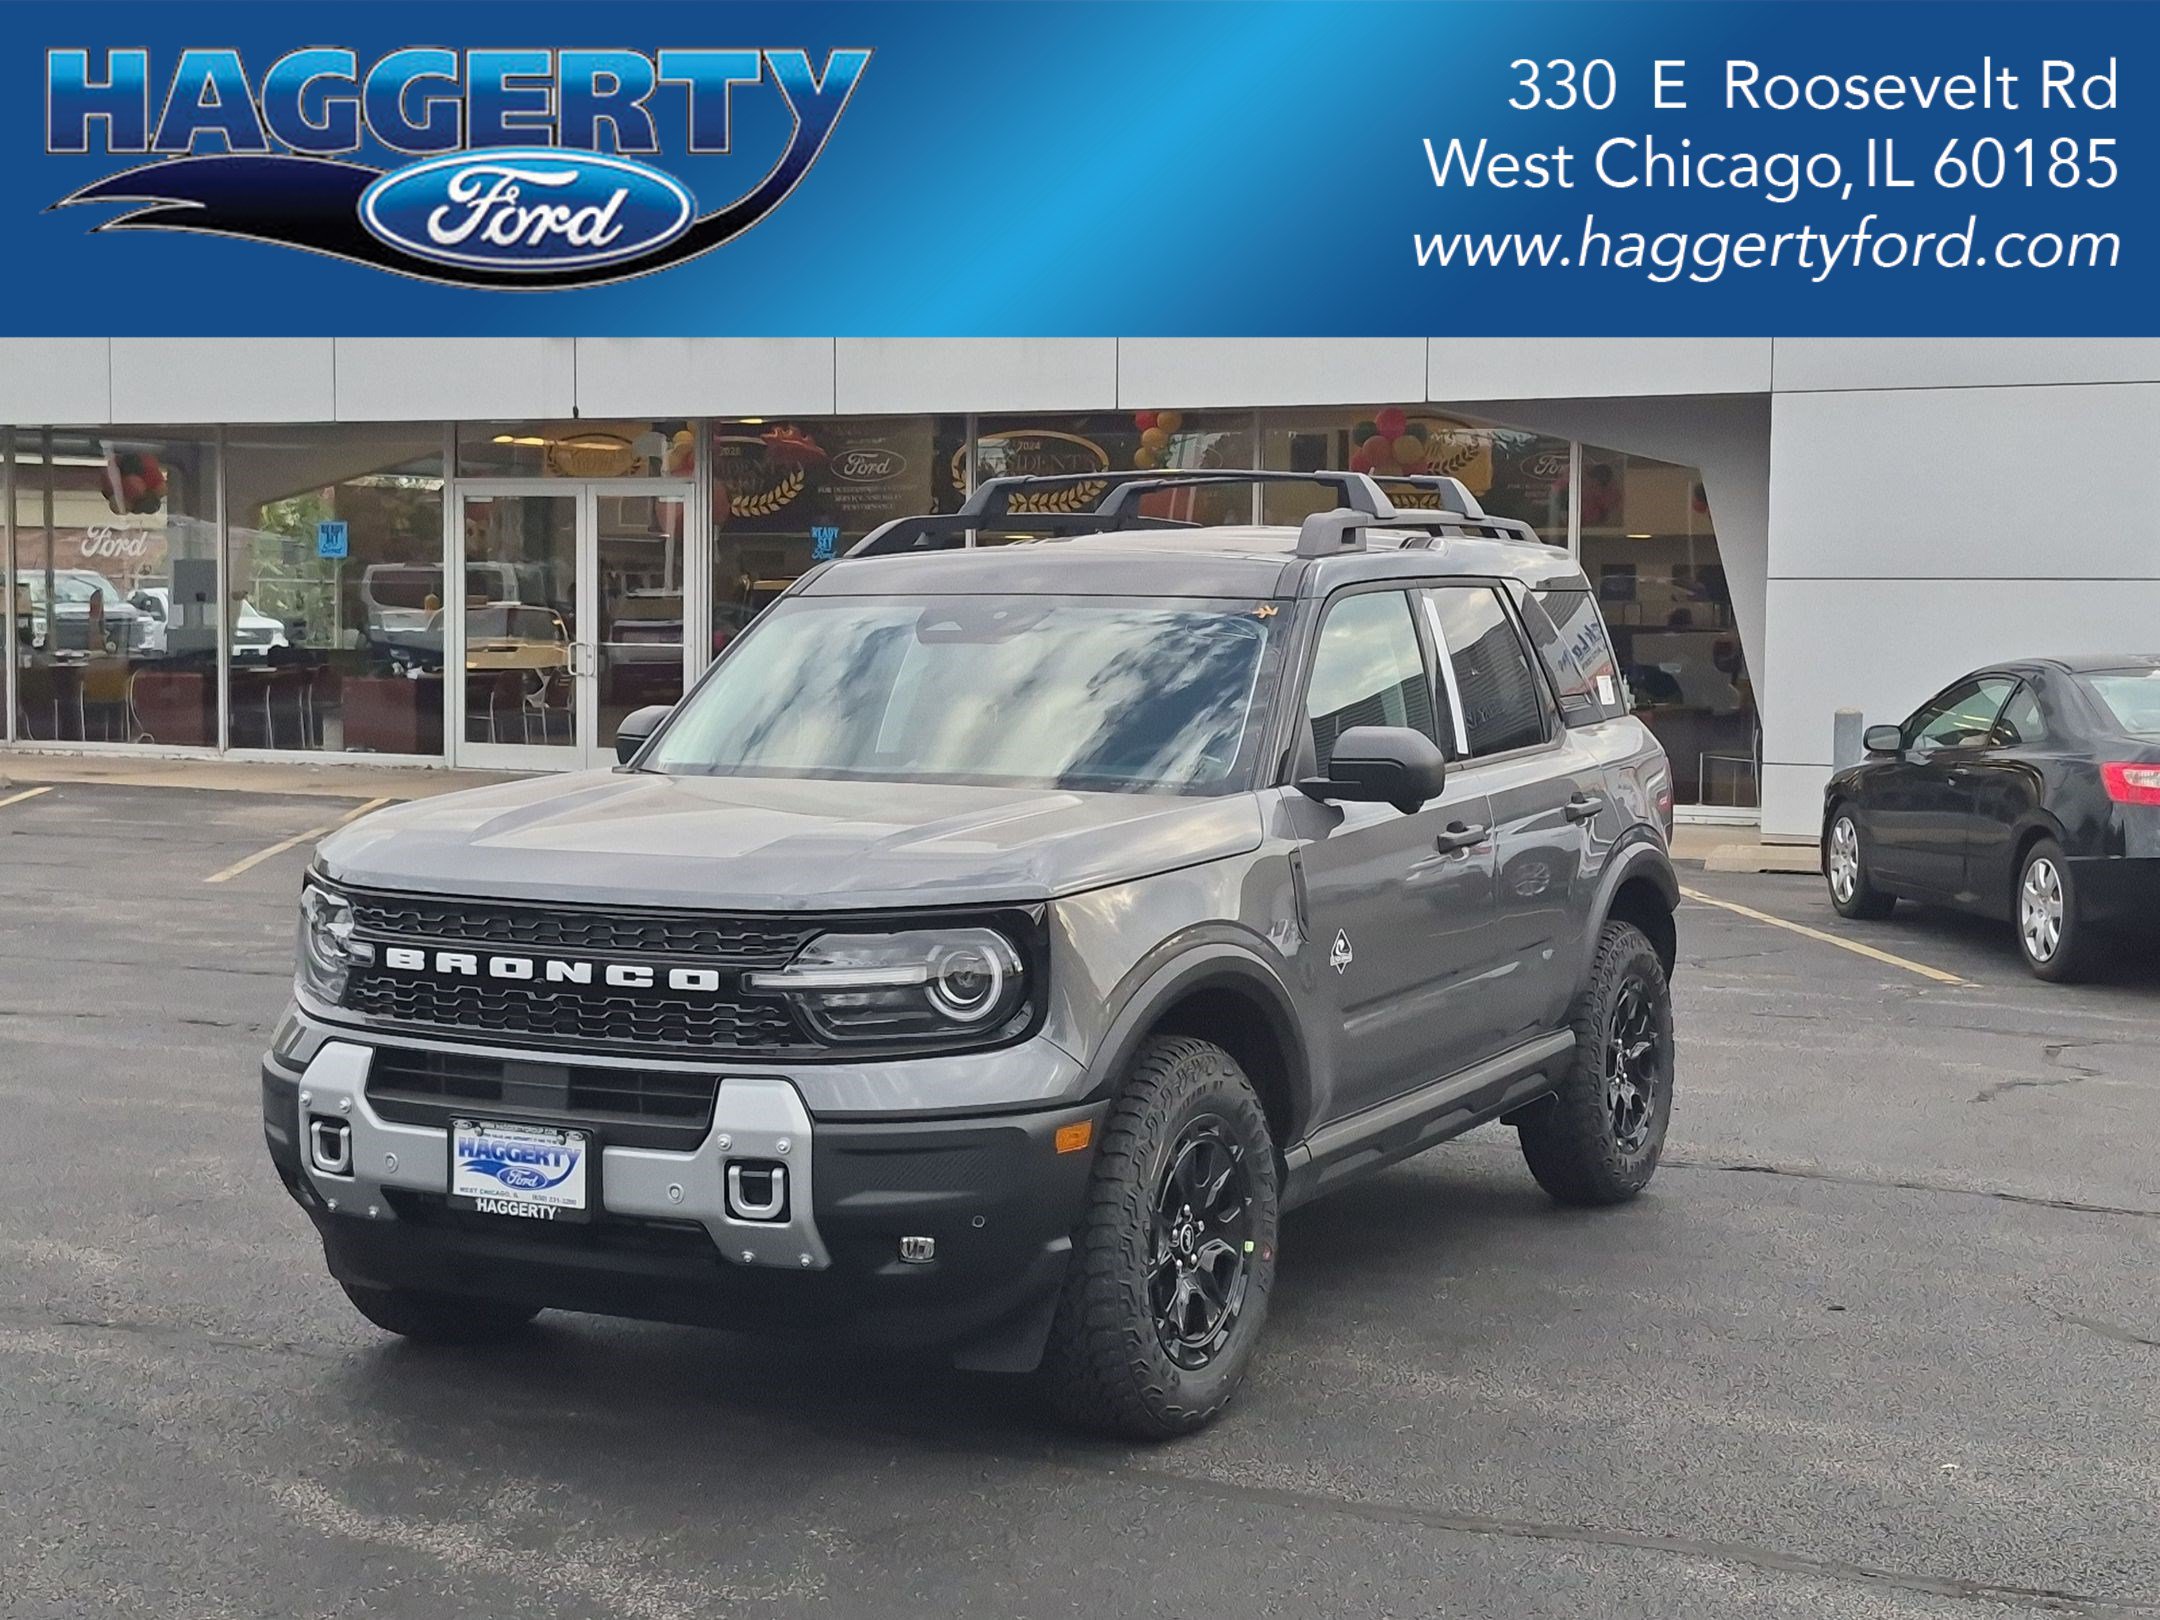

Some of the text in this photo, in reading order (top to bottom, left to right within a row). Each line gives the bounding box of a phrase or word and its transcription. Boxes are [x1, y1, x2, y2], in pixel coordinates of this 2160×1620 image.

[844, 453, 891, 475] Ford
[81, 525, 149, 558] Ford
[386, 947, 720, 992] BRONCO
[458, 1136, 582, 1168] HAGGERTY
[506, 1168, 538, 1187] Ford
[477, 1198, 557, 1221] HAGGERTY
